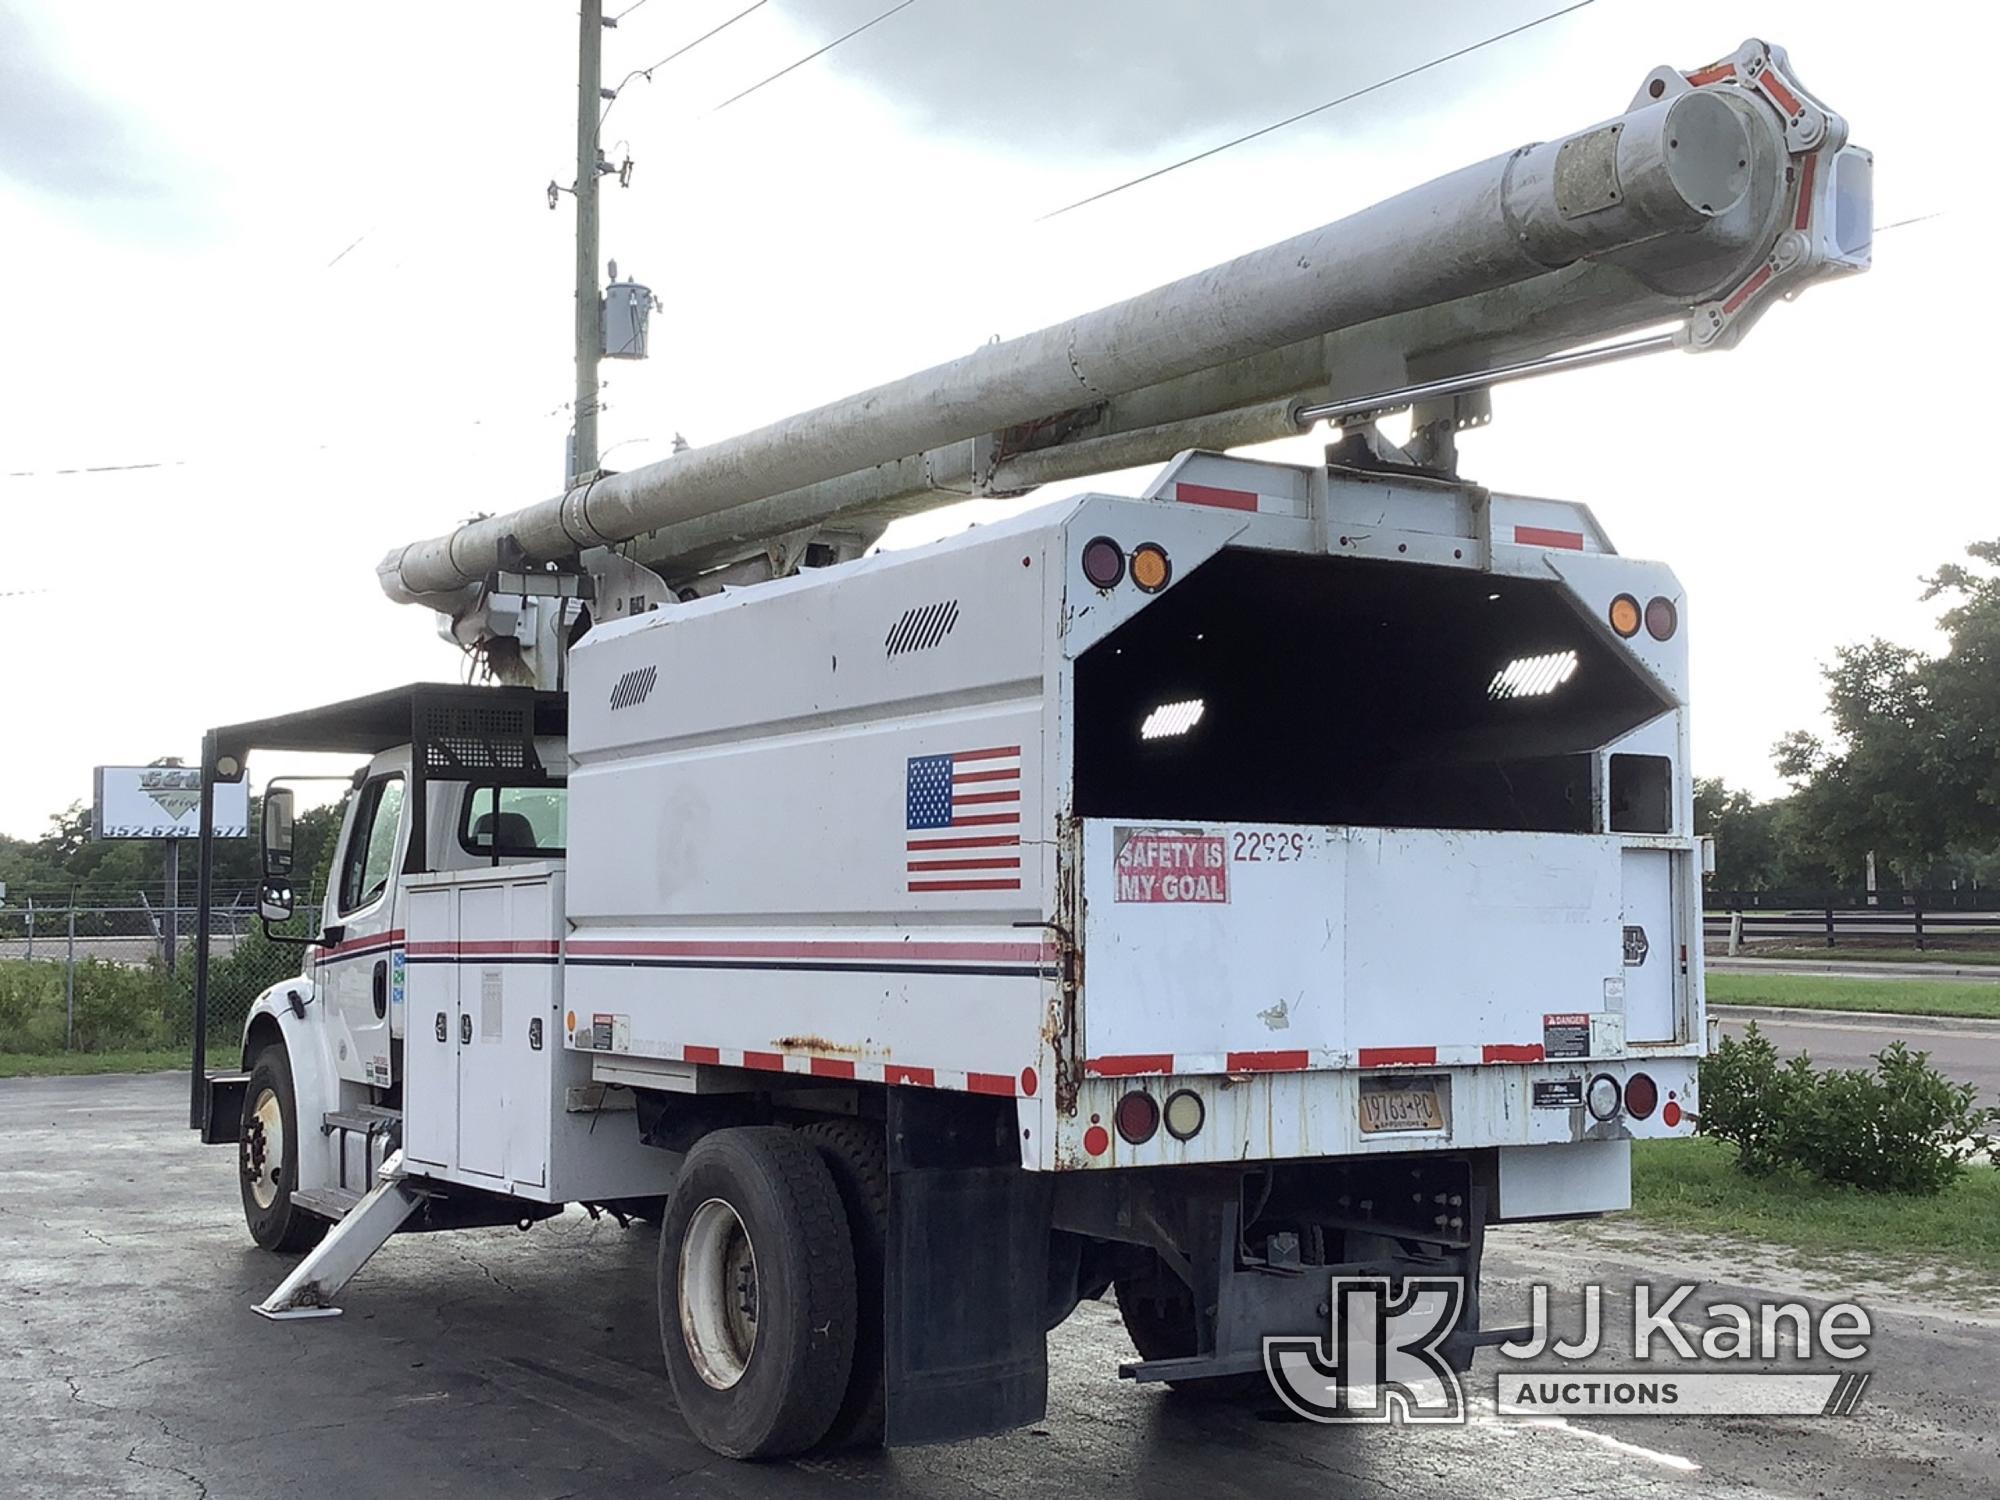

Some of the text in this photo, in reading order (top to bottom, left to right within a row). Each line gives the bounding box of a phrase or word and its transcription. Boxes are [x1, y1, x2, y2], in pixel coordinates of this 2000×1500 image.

[103, 825, 246, 837] 352-629-677
[1120, 842, 1222, 868] SAFETY IS
[1121, 874, 1224, 901] MY GOAL
